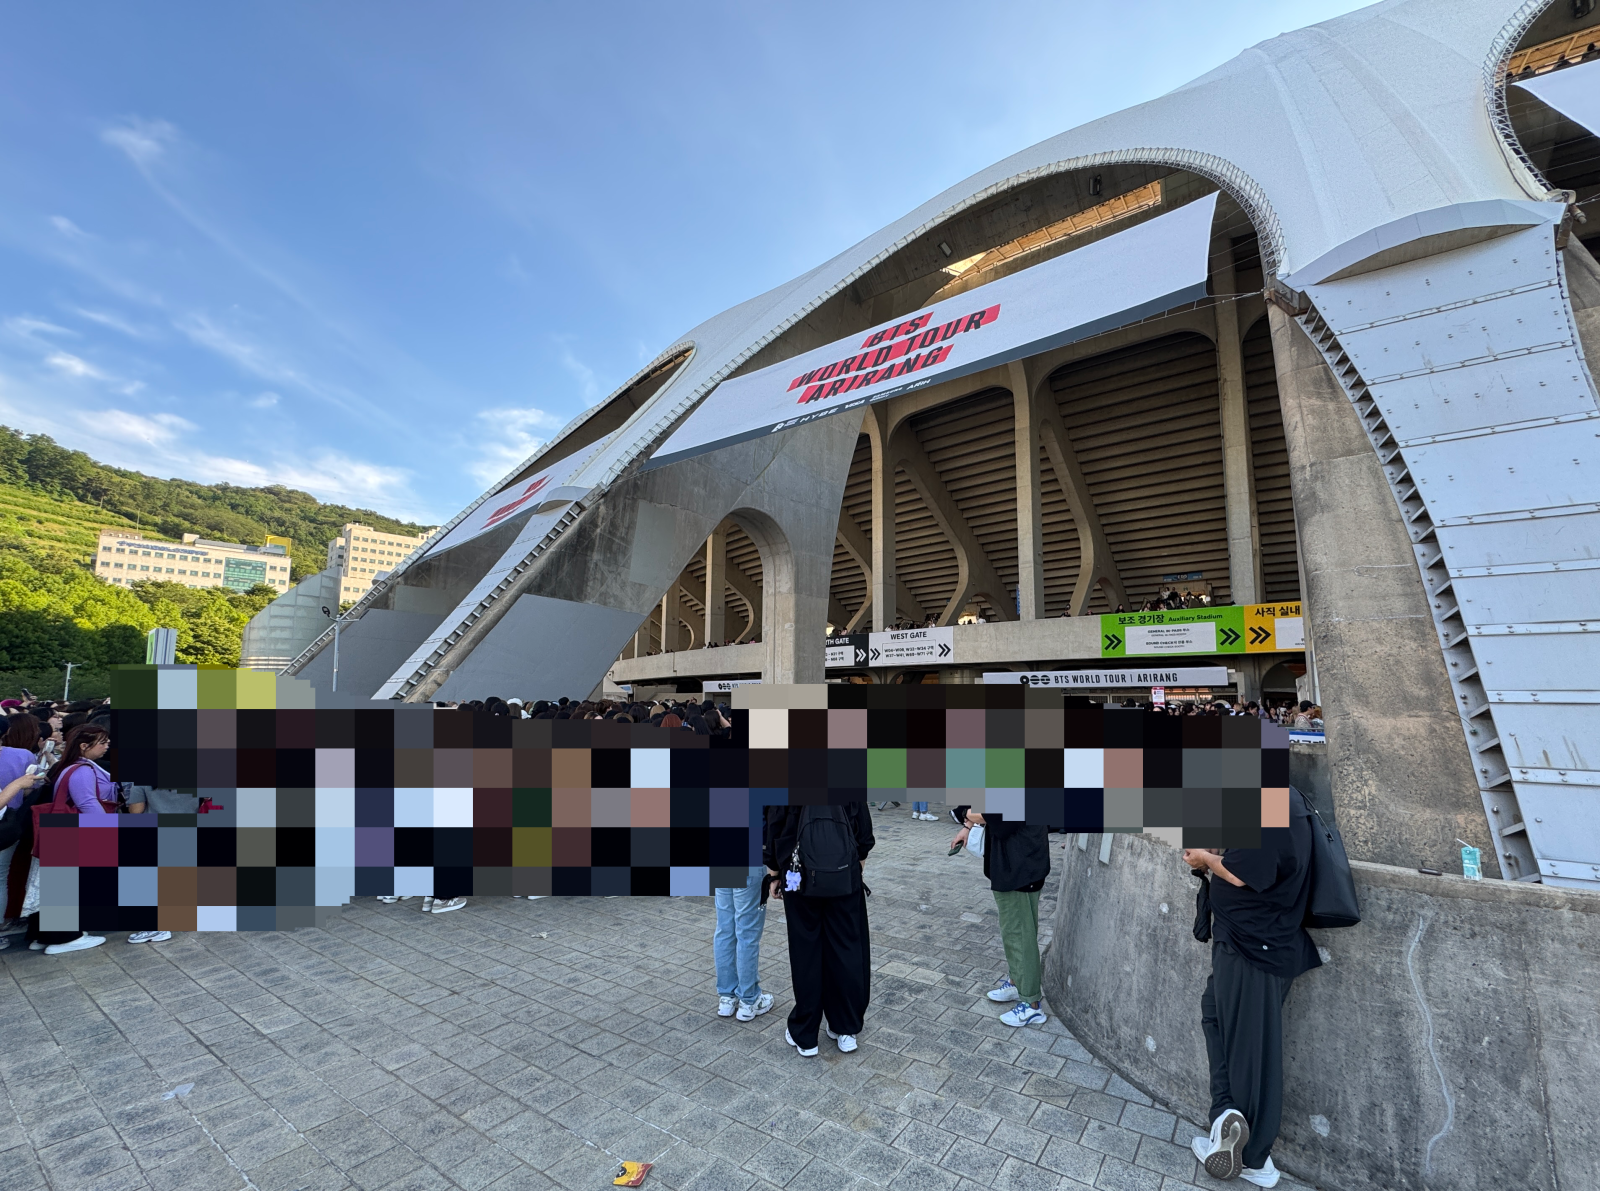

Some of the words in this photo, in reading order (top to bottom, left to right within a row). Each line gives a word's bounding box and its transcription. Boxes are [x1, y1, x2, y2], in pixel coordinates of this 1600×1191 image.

[867, 315, 924, 349] BTS
[797, 345, 893, 388] WORLD
[904, 310, 987, 356] TOUR
[804, 345, 944, 405] ARIRANG
[1255, 607, 1275, 617] 사직
[1118, 616, 1135, 624] 보조
[1138, 614, 1165, 624] 경기장
[890, 632, 909, 640] WEST
[909, 631, 927, 639] GATE
[835, 637, 850, 645] GATE
[1054, 675, 1069, 684] BTS
[1072, 674, 1100, 684] WORLD
[1104, 674, 1126, 683] TOUR
[1137, 673, 1178, 682] ARIRANG
